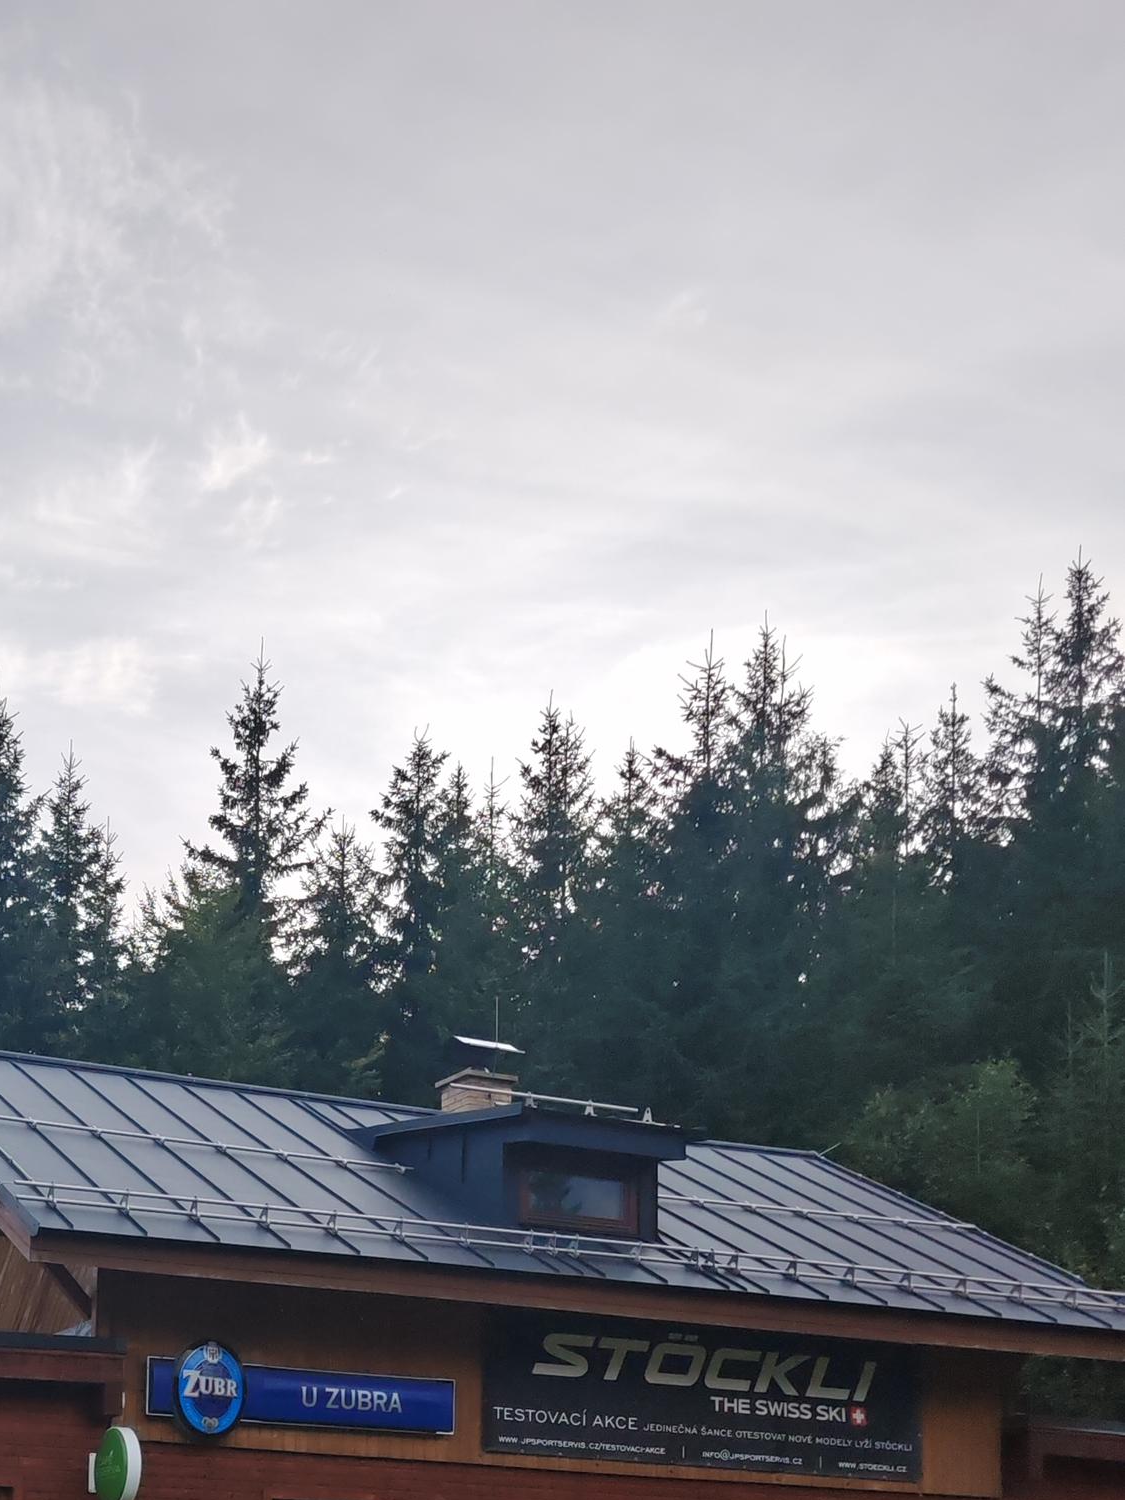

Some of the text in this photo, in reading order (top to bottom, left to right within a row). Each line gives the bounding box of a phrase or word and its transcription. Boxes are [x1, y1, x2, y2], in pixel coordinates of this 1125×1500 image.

[531, 1332, 878, 1402] STÖCKLI
[182, 1369, 238, 1398] ZUBR
[301, 1386, 403, 1413] U ZUBRA
[709, 1396, 847, 1423] THE SWISS SKI
[492, 1406, 588, 1427] TESTOVACÍ
[592, 1415, 639, 1431] AKCE
[643, 1422, 698, 1436] JEDINEČNÁ
[701, 1426, 733, 1439] ŠANCE
[735, 1430, 787, 1442] OTESTOVAT
[788, 1434, 813, 1445] NOVÉ
[815, 1437, 853, 1448] MODELY
